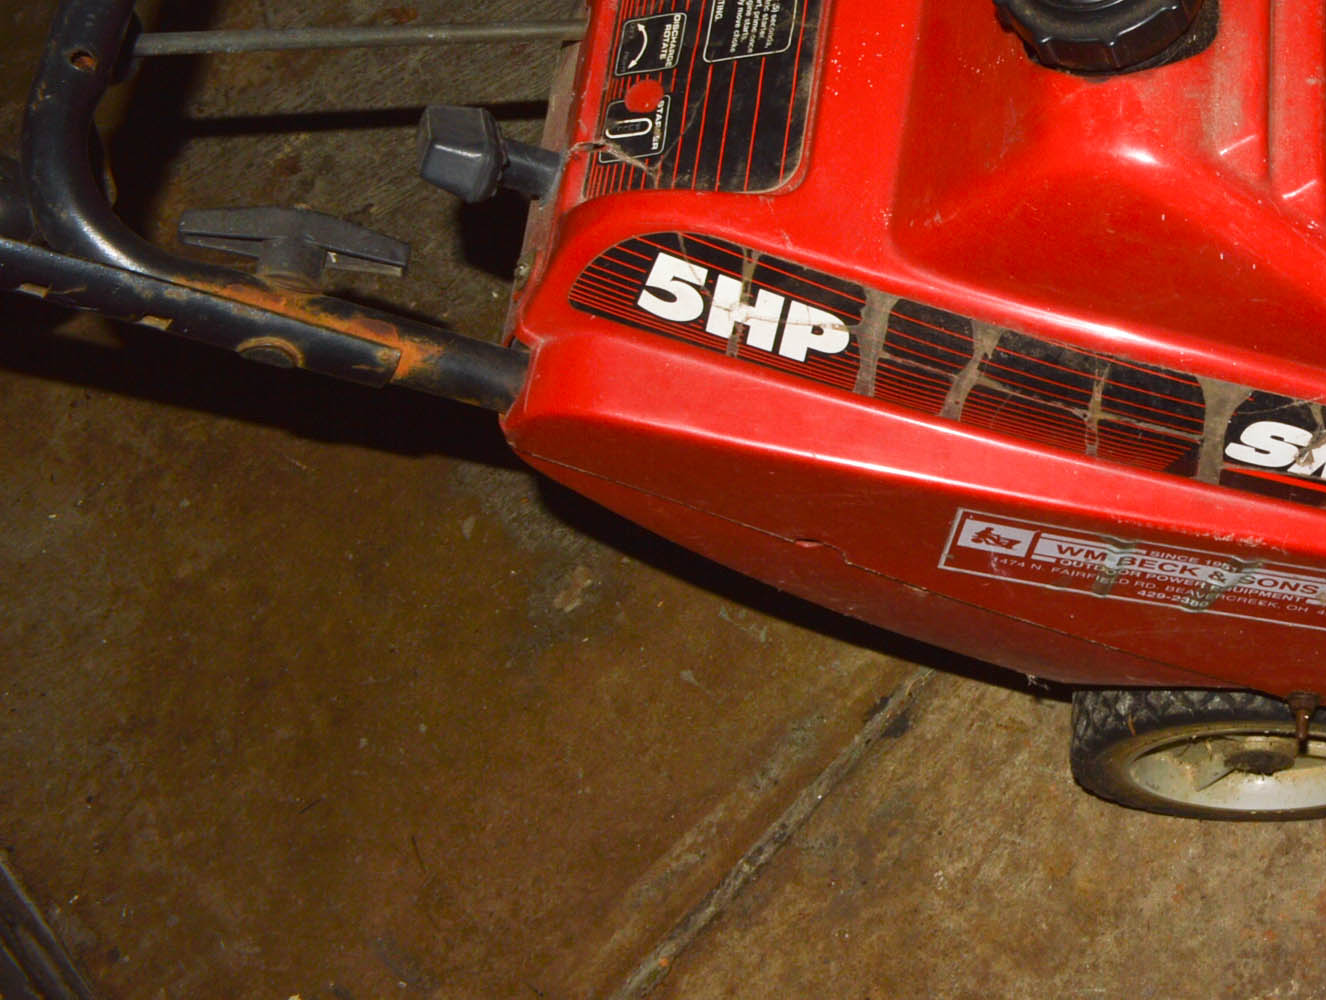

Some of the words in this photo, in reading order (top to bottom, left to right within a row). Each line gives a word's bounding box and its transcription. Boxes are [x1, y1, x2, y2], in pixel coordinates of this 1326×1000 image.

[734, 7, 743, 28] move
[659, 24, 672, 60] ROTATE
[665, 14, 682, 67] DISCHARGE
[637, 252, 851, 361] 5HP
[1056, 544, 1108, 561] WM
[1117, 556, 1200, 577] BECK
[1208, 570, 1226, 584] &
[1239, 575, 1319, 595] SONS
[1059, 559, 1141, 577] OUTDOOR
[1145, 573, 1206, 589] POWER
[1150, 550, 1201, 565] SINCE
[1286, 604, 1309, 613] OH
